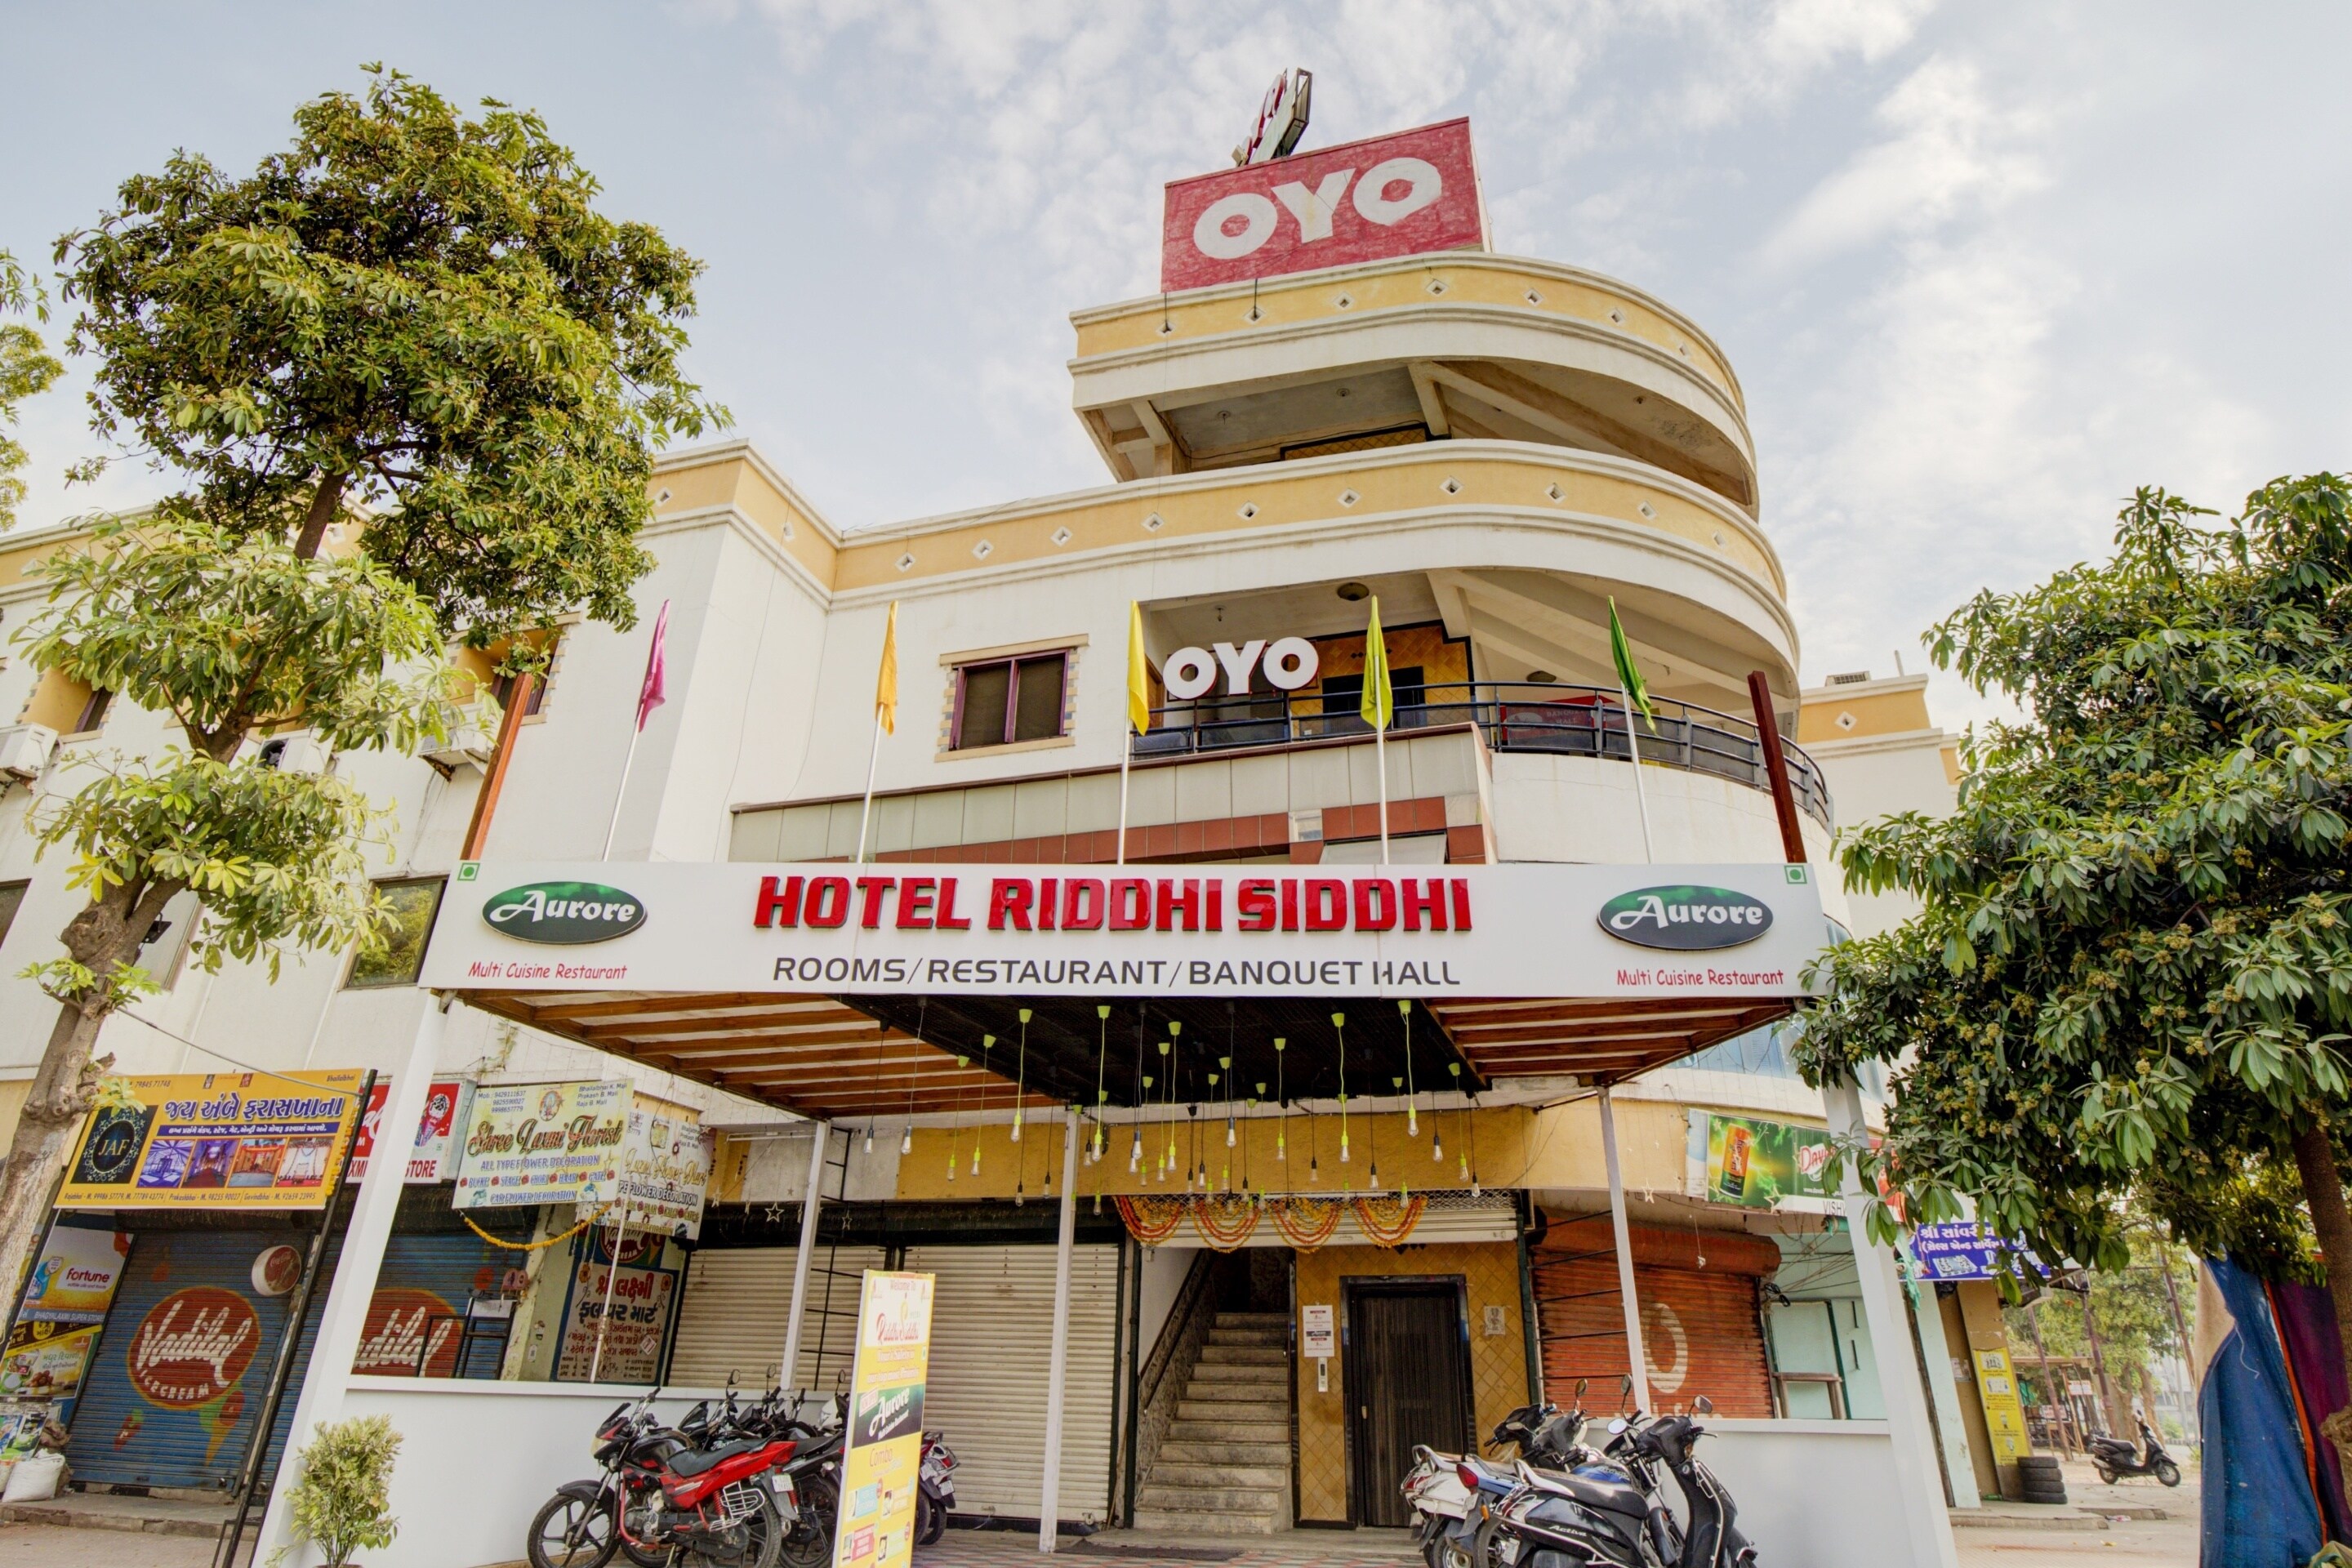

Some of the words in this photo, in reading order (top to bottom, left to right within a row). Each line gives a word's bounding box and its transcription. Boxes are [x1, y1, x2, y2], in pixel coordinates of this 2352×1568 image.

[1193, 157, 1442, 259] OYO
[1163, 637, 1319, 700] OYO
[489, 890, 635, 922] Aurore
[753, 875, 972, 929] HOTEL
[987, 878, 1223, 932] RIDDHI
[1238, 878, 1472, 932] SIDDHI
[1610, 895, 1762, 929] Aurore
[468, 961, 501, 978] Multi
[506, 963, 550, 979] Cuisine
[555, 963, 628, 979] Restaurant
[1373, 961, 1460, 986] HALL
[1617, 969, 1651, 986] Multi
[1656, 969, 1704, 986] Cuisine
[1708, 969, 1784, 986] Restaurant
[165, 1100, 197, 1120] જય
[201, 1092, 240, 1120] અંબે
[243, 1098, 344, 1120] ફરાસખાના
[98, 1139, 130, 1156] JAF
[467, 1120, 514, 1158] Shree
[516, 1118, 568, 1156] Laxmi
[568, 1114, 624, 1152] Florist
[497, 1160, 516, 1170] TYPE
[550, 1156, 600, 1168] DECORATION
[66, 1267, 111, 1283] fortune
[136, 1299, 252, 1388] Vadilal
[353, 1307, 453, 1377] adilal
[139, 1369, 158, 1393] ICE
[160, 1382, 211, 1400] CREAM
[868, 1388, 909, 1437] Aurore
[1550, 1526, 1588, 1537] Activa
